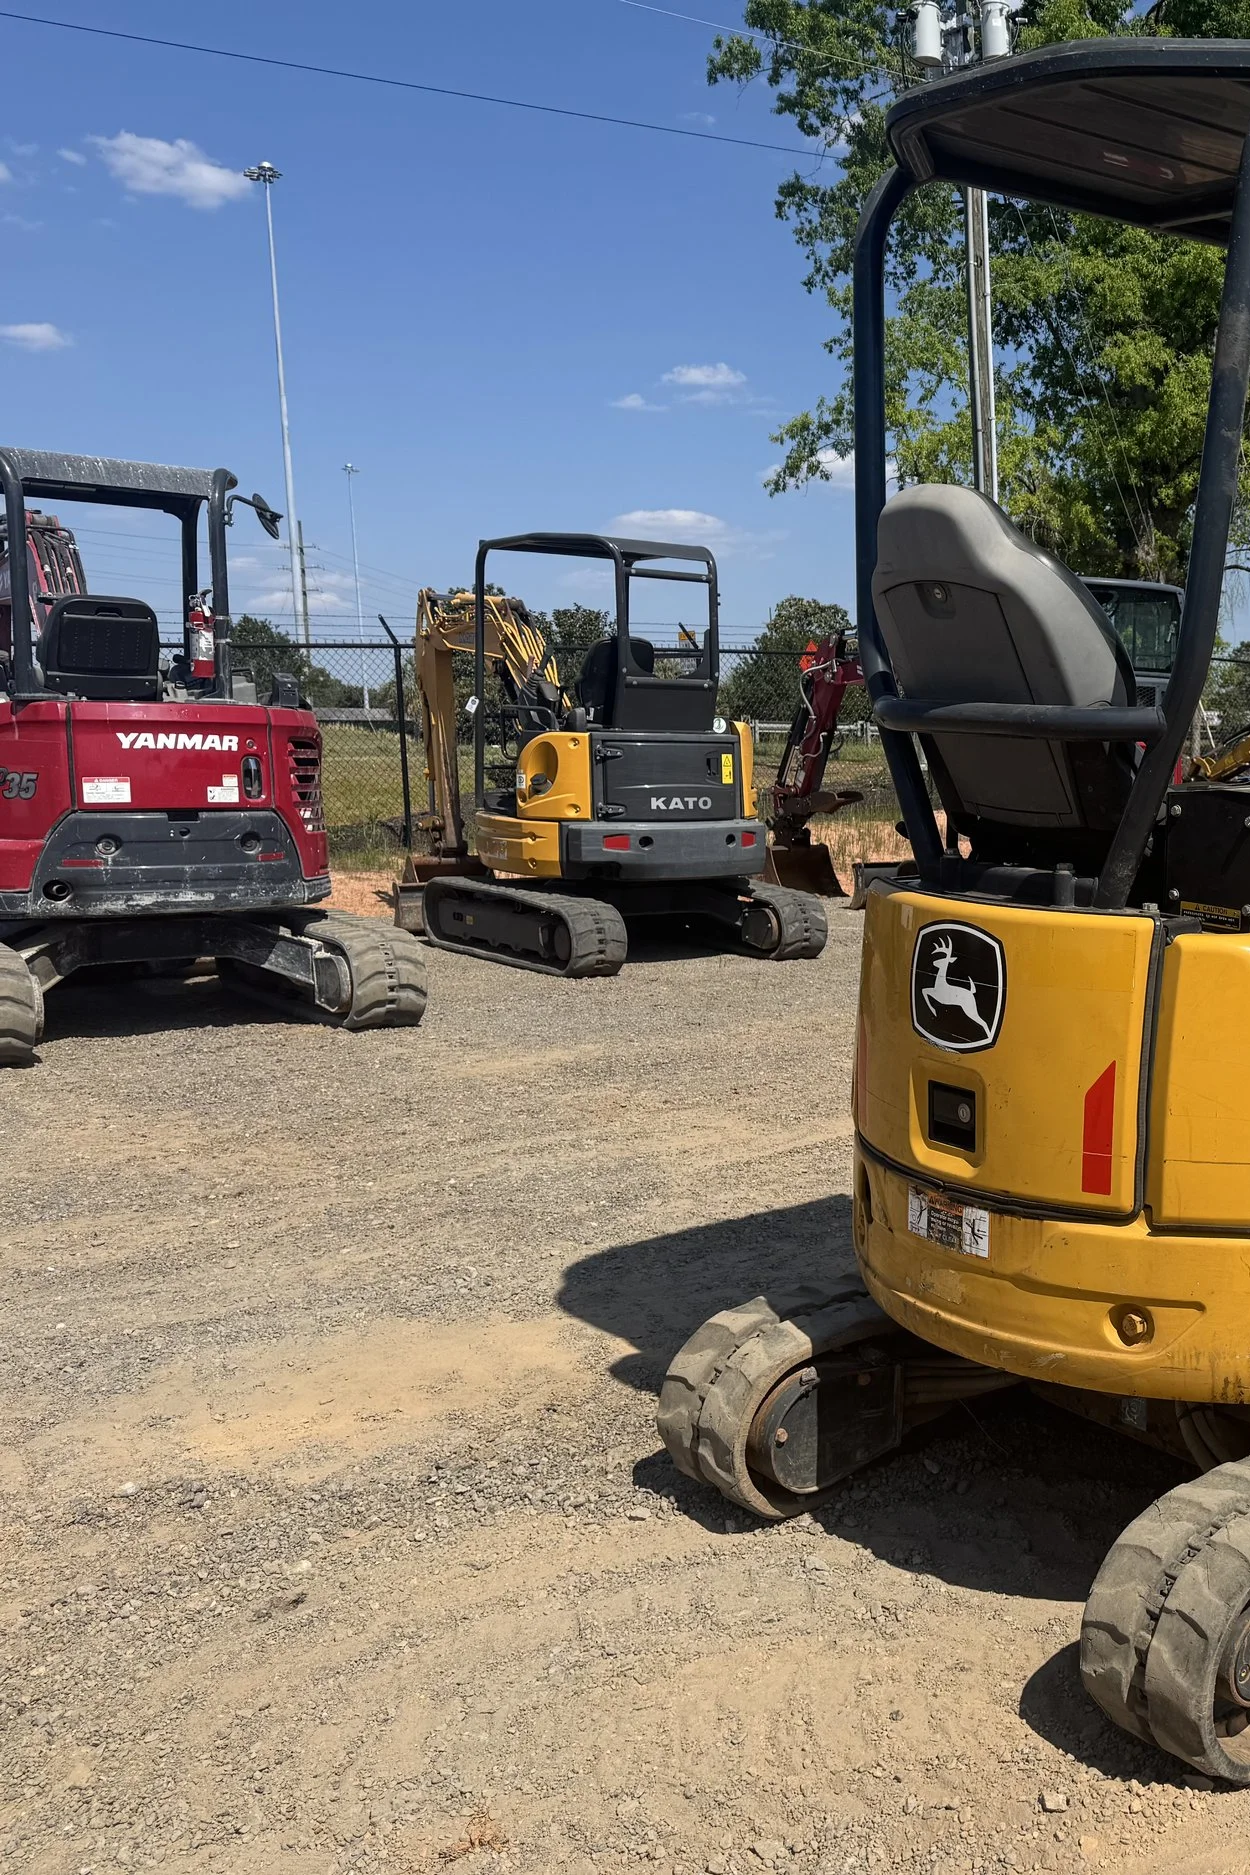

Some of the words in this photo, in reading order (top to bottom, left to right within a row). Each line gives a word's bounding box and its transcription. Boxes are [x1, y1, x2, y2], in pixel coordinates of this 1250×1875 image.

[116, 732, 239, 752] YANMAR
[650, 796, 712, 810] KATO
[1202, 905, 1228, 915] CAUTION
